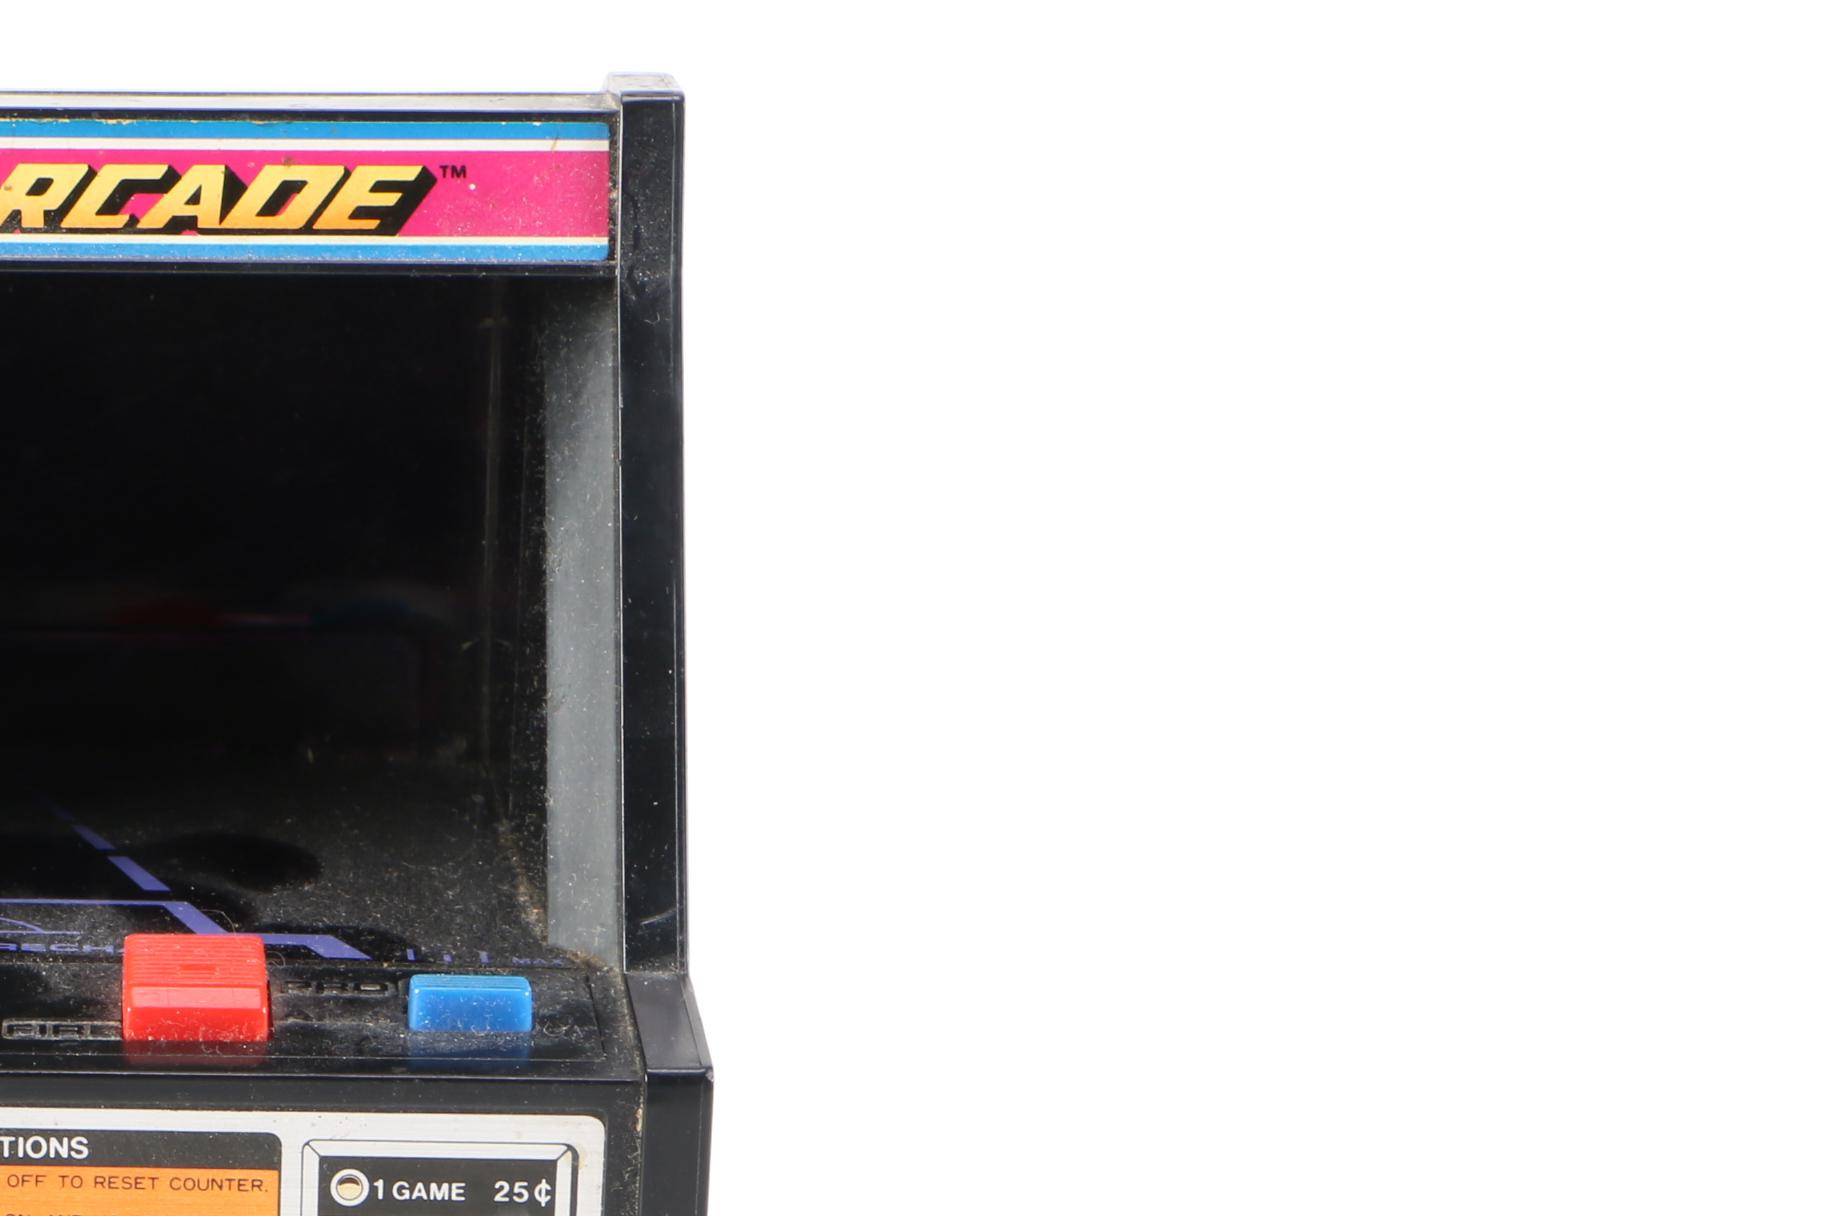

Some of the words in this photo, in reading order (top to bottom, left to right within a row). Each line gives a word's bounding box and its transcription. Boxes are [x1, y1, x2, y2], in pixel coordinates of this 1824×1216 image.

[7, 1175, 45, 1188] OFF
[59, 1176, 83, 1188] TO
[94, 1176, 159, 1190] RESET
[169, 1177, 268, 1192] COUNTER.
[374, 1179, 384, 1199] 1
[392, 1182, 465, 1201] GAME
